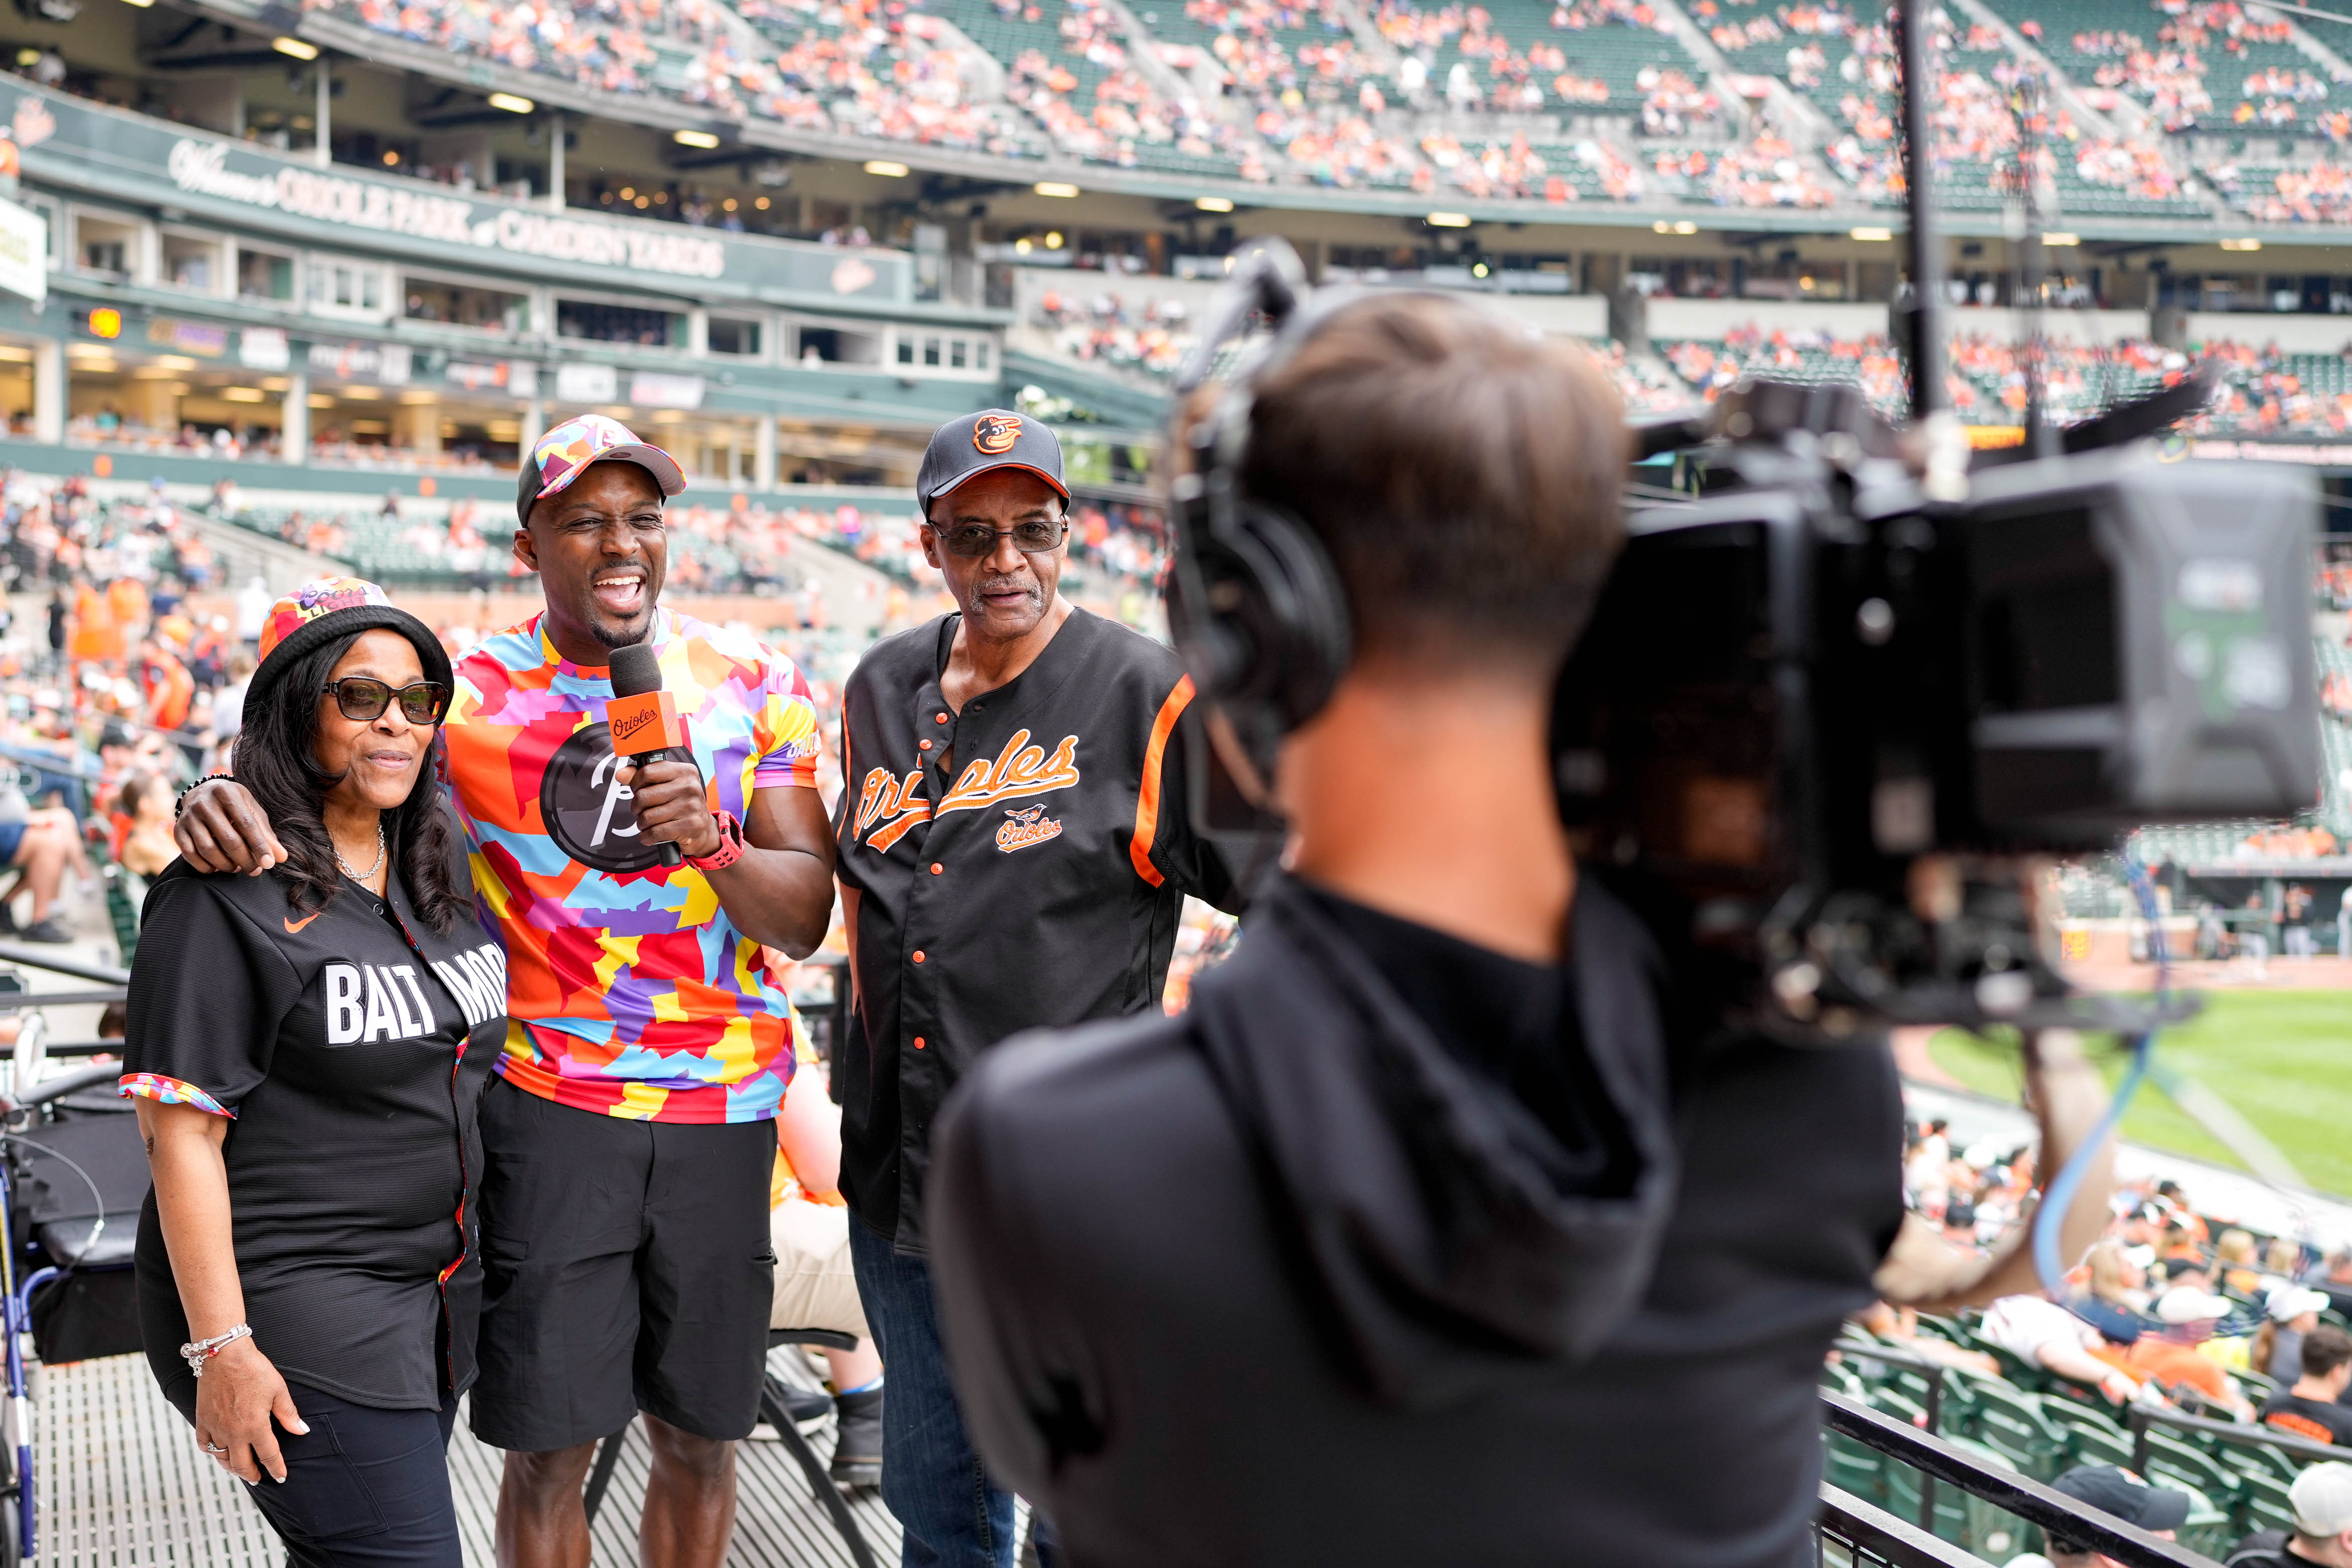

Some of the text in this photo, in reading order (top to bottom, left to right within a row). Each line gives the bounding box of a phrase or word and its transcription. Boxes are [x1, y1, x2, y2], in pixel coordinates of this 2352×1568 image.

[392, 189, 473, 245] PARK
[300, 586, 369, 611] Coors
[310, 596, 366, 618] LIGHT
[613, 708, 658, 740] Orioles
[996, 817, 1063, 853] Orioles
